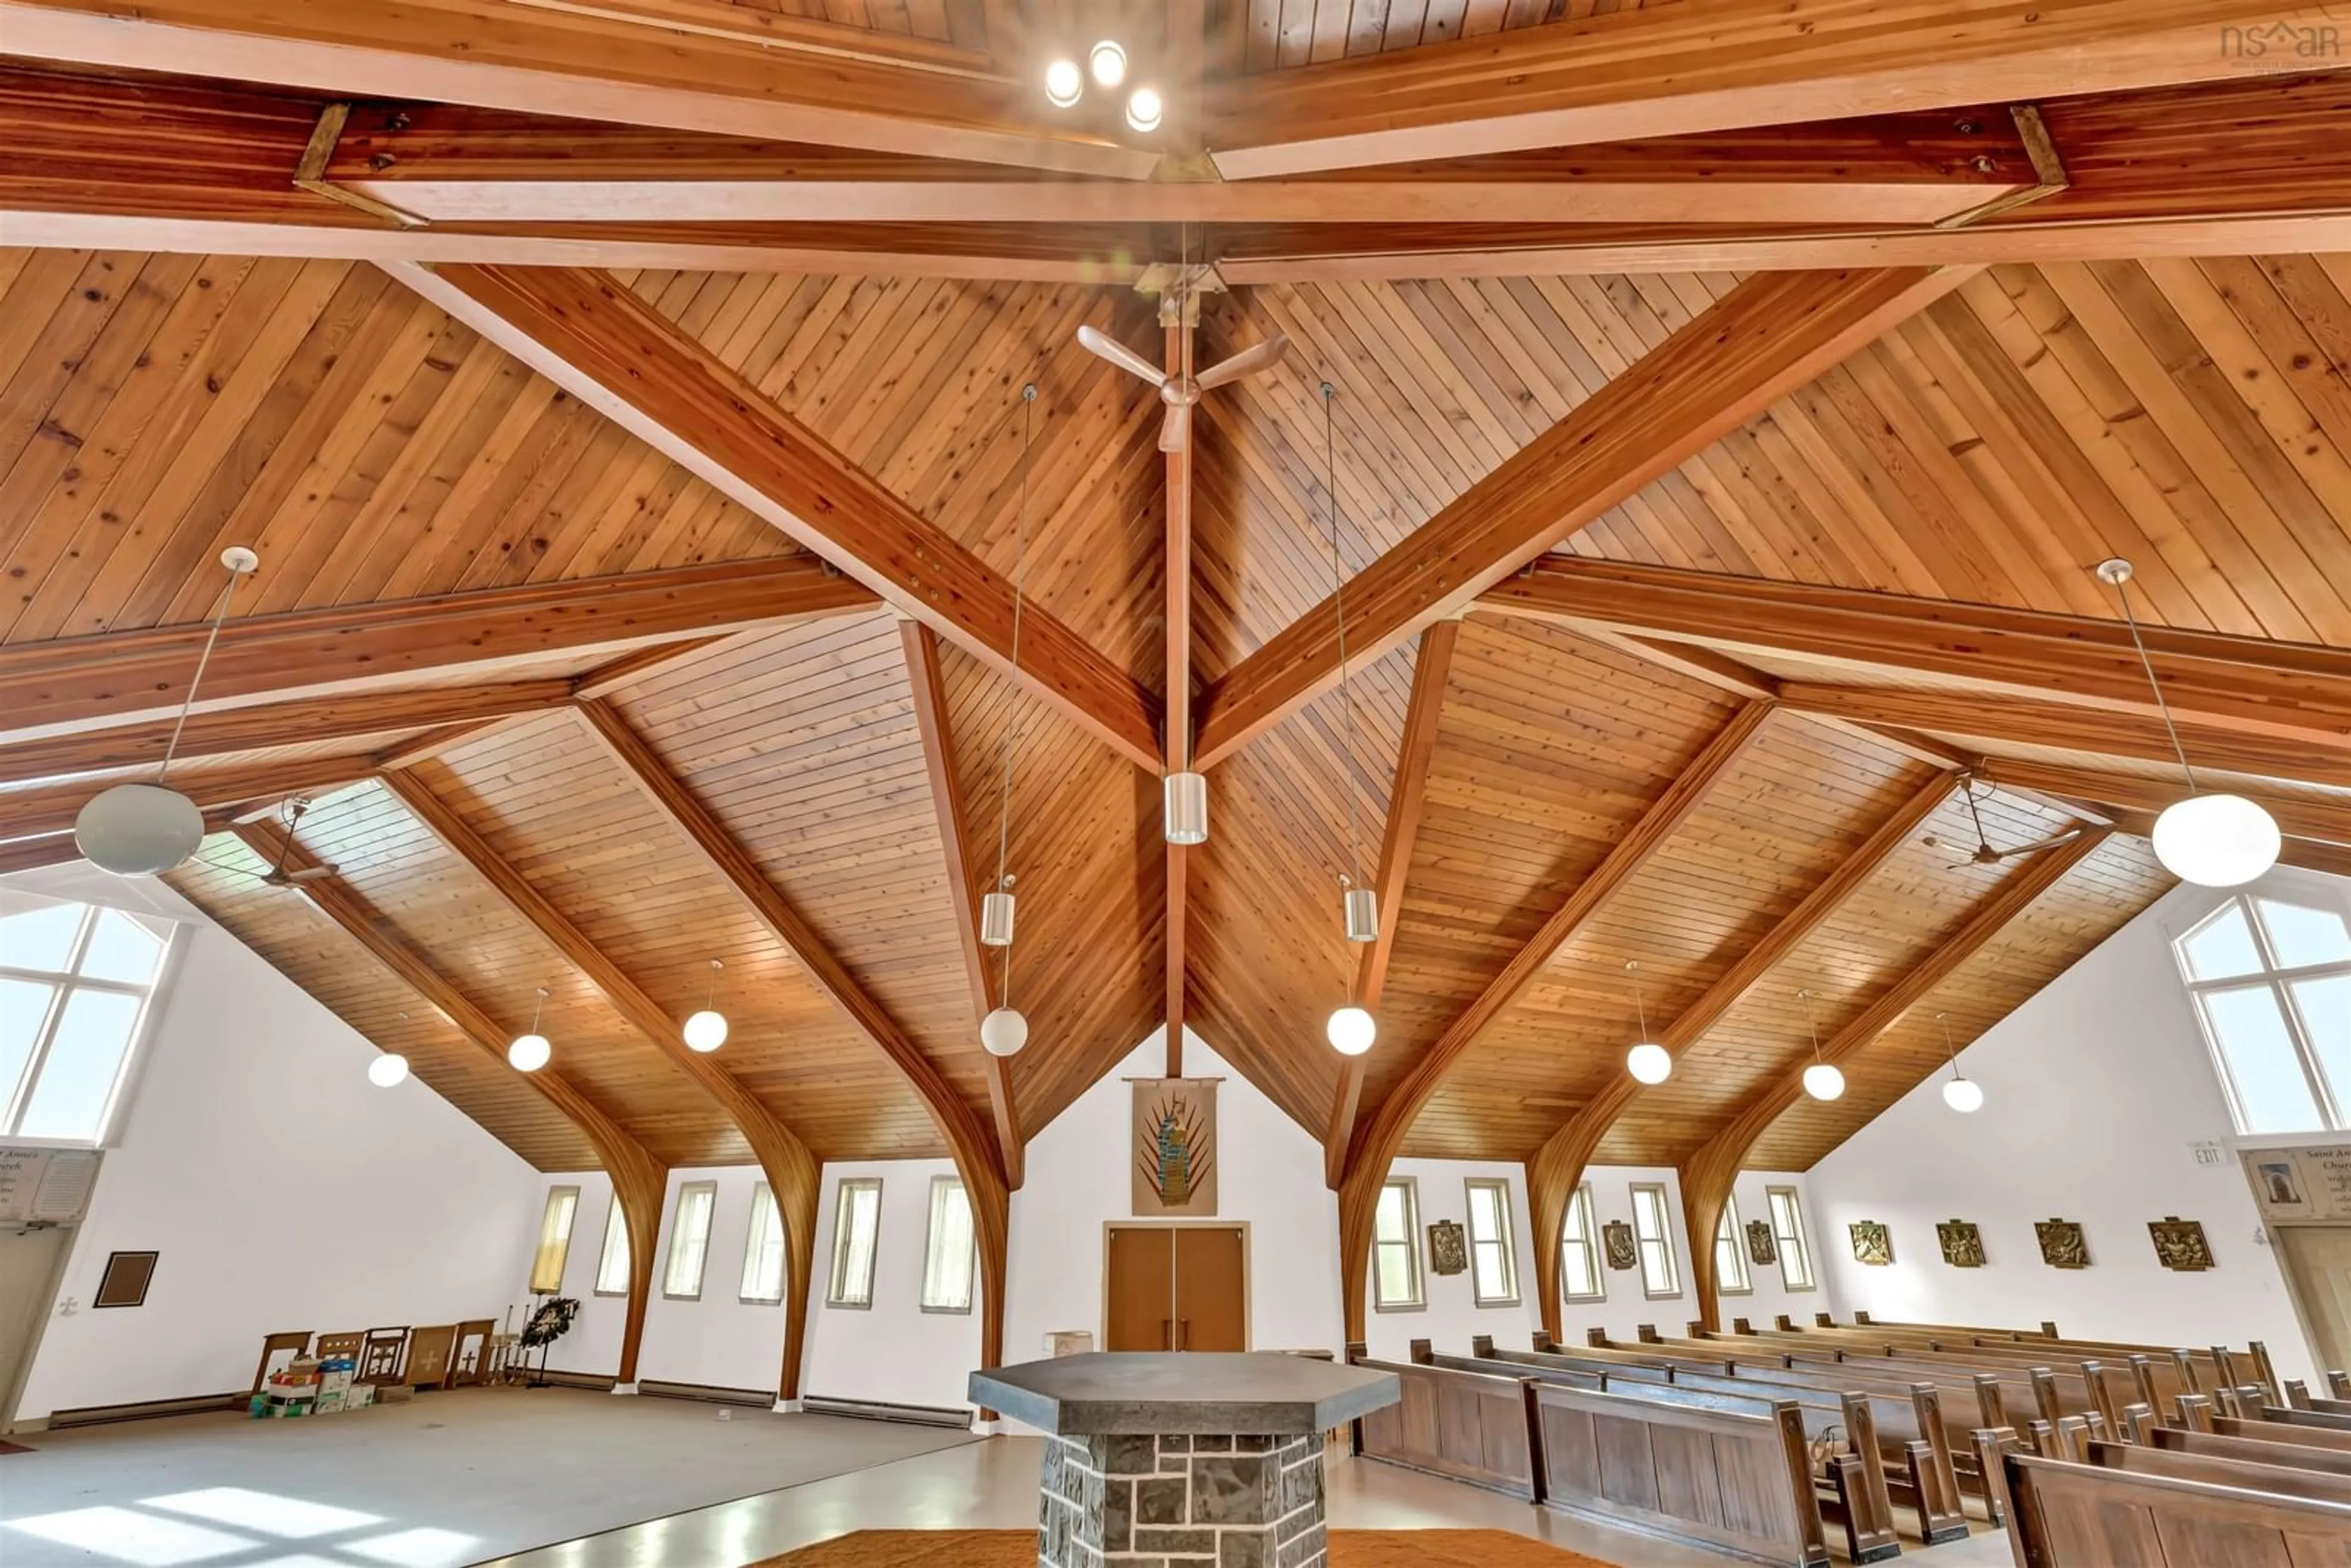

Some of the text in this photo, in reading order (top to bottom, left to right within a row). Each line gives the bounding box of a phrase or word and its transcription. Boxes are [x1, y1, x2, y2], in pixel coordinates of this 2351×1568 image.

[2195, 1149, 2219, 1163] EXIT
[2336, 1149, 2351, 1157] An
[0, 1161, 21, 1170] urch
[2323, 1160, 2351, 1169] Chur
